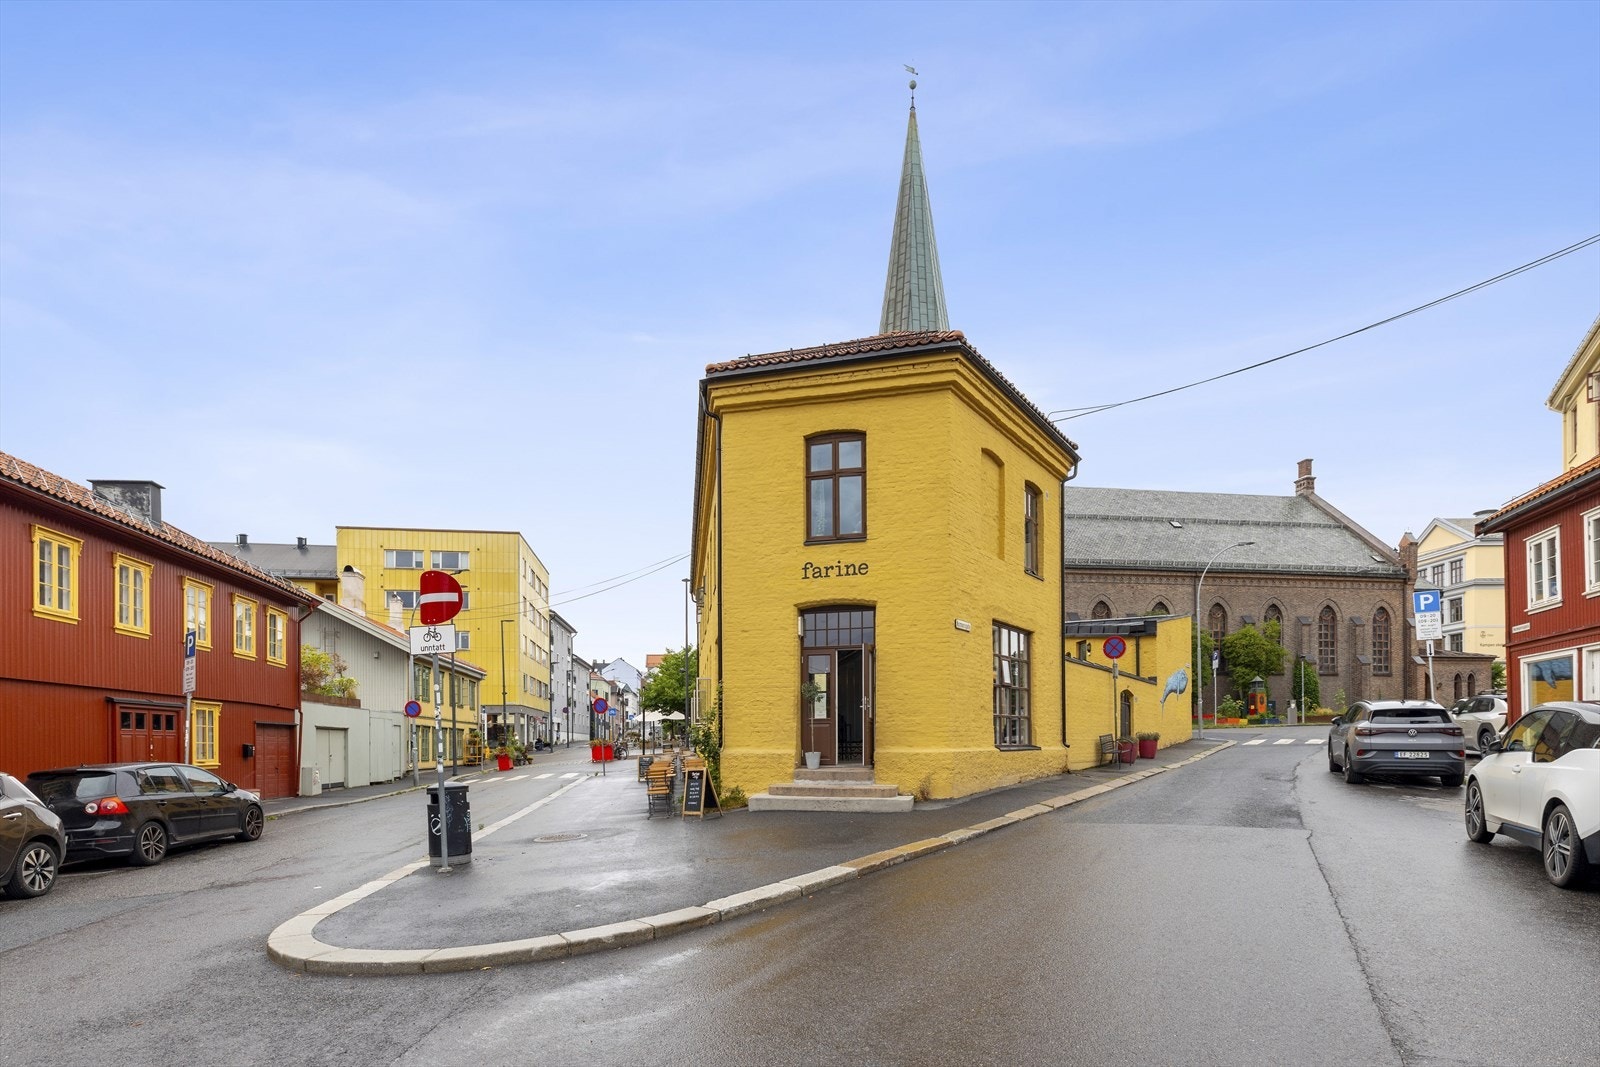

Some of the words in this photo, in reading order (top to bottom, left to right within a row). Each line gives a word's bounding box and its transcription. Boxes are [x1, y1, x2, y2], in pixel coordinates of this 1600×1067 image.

[801, 560, 869, 580] farine
[1420, 594, 1434, 610] P
[187, 635, 194, 655] P
[420, 644, 446, 652] unntatt
